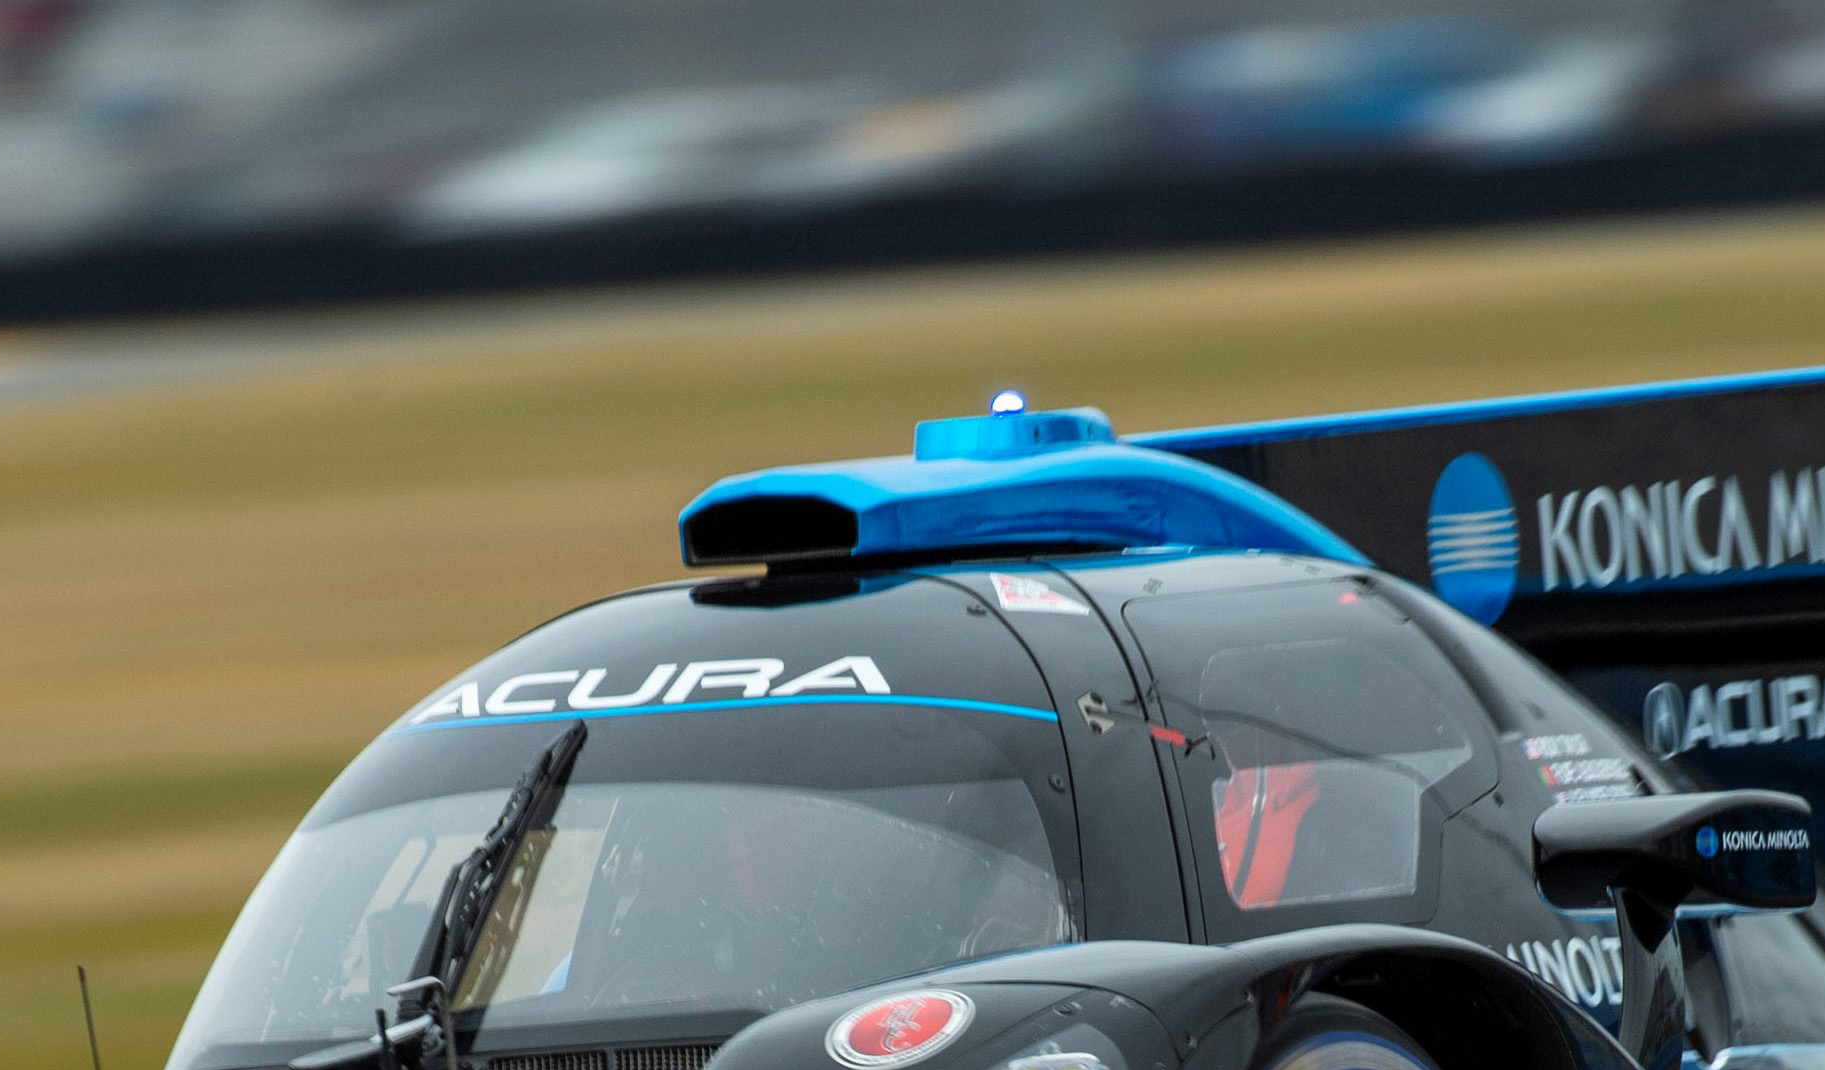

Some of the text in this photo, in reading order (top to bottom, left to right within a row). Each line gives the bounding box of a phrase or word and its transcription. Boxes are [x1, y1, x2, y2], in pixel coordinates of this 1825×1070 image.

[1537, 473, 1763, 592] KONICA
[410, 656, 891, 726] ACURA
[1722, 829, 1810, 852] KONICA MINOLTA
